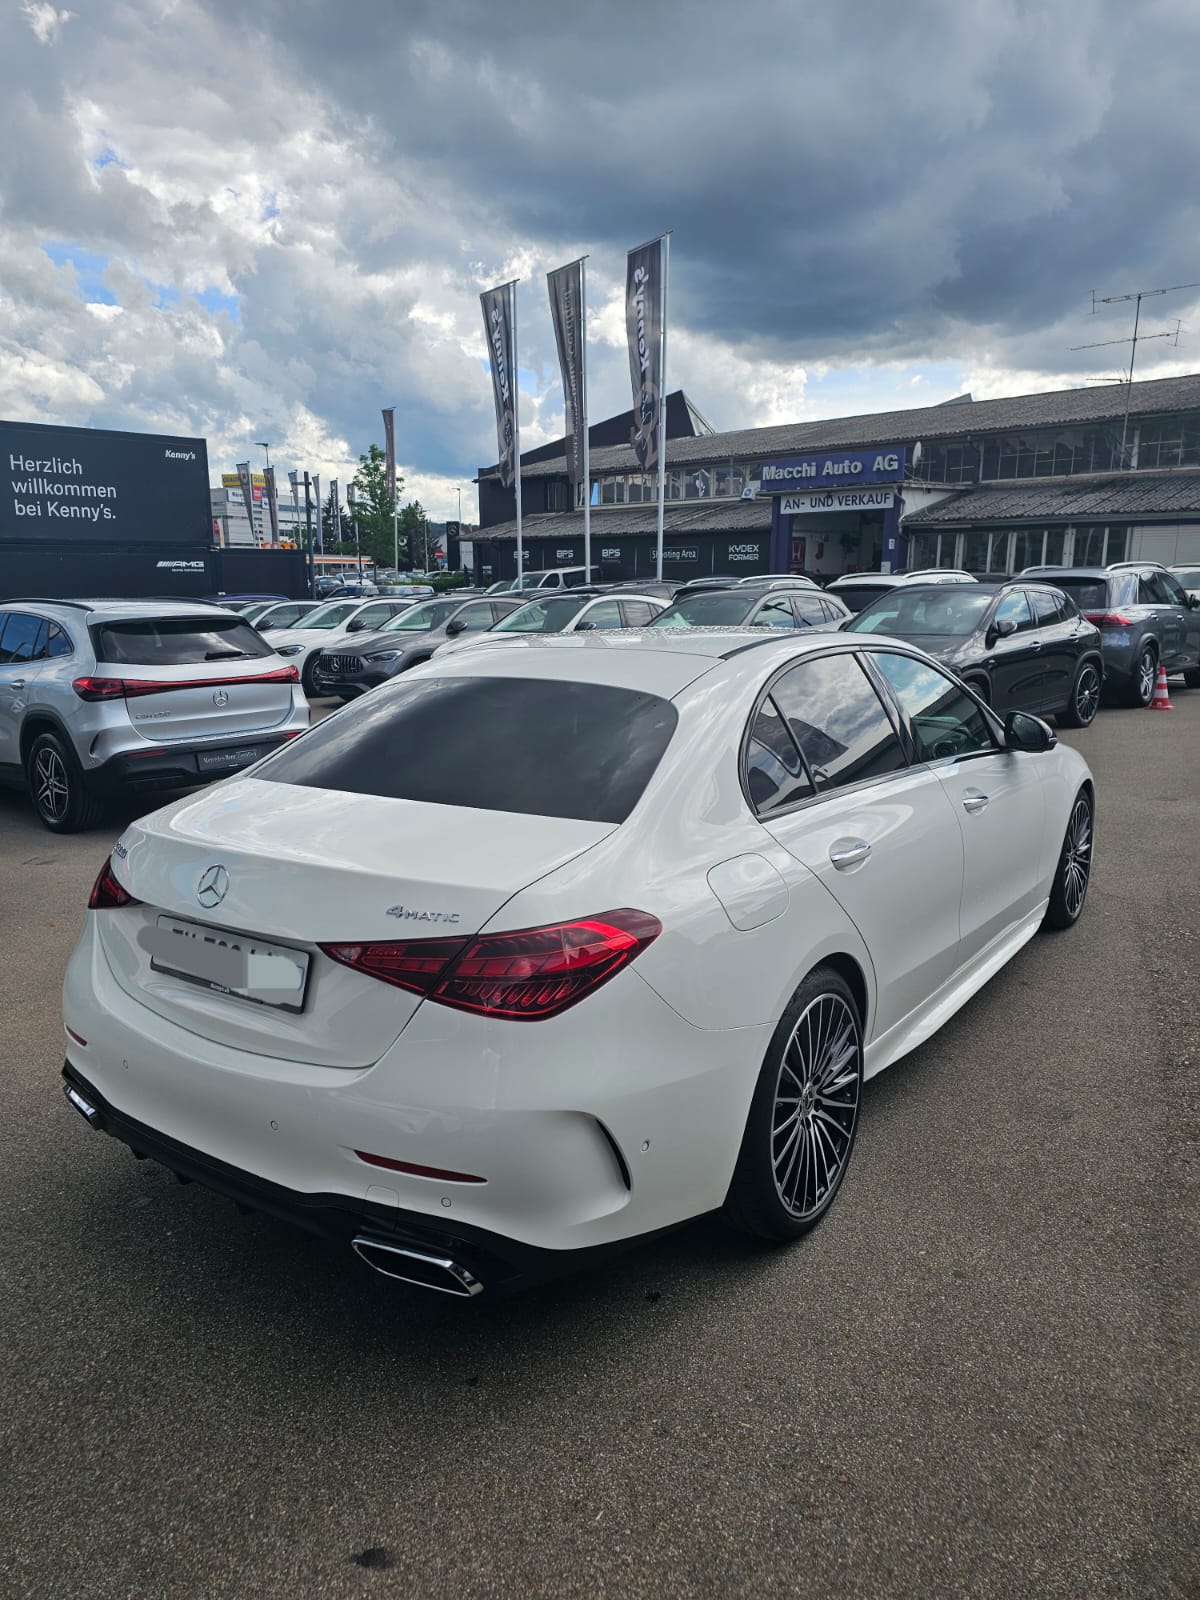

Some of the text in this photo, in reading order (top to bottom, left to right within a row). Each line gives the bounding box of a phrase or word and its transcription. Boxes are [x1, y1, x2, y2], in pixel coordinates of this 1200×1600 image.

[165, 449, 196, 460] Kenny's
[10, 454, 82, 475] Herzlich
[762, 454, 899, 480] Macchi Auto AG
[11, 477, 117, 498] willkommen
[784, 492, 891, 510] AN- UND VERKAUF
[14, 499, 117, 522] bei Kenny's.
[556, 550, 574, 558] BPS
[601, 548, 621, 557] BPS
[651, 549, 697, 560] Soting Area
[728, 544, 760, 553] KYDEX
[728, 553, 760, 561] FORMER
[386, 904, 460, 923] 4MATIC
